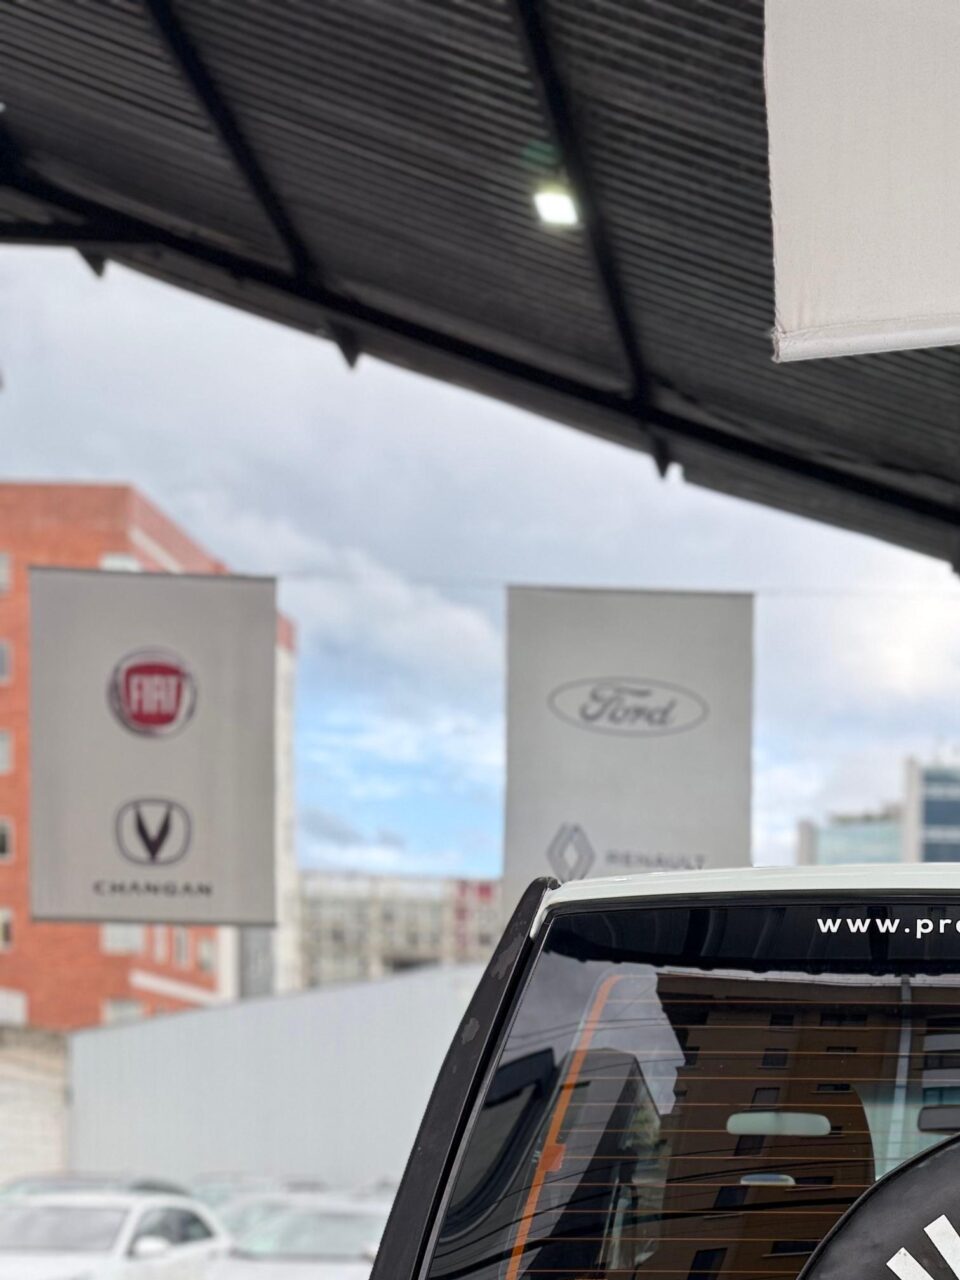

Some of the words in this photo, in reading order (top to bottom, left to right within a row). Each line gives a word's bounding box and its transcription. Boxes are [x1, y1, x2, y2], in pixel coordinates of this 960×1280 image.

[129, 673, 182, 714] FIAT
[579, 684, 677, 726] Ford
[93, 880, 213, 897] CHANGAN
